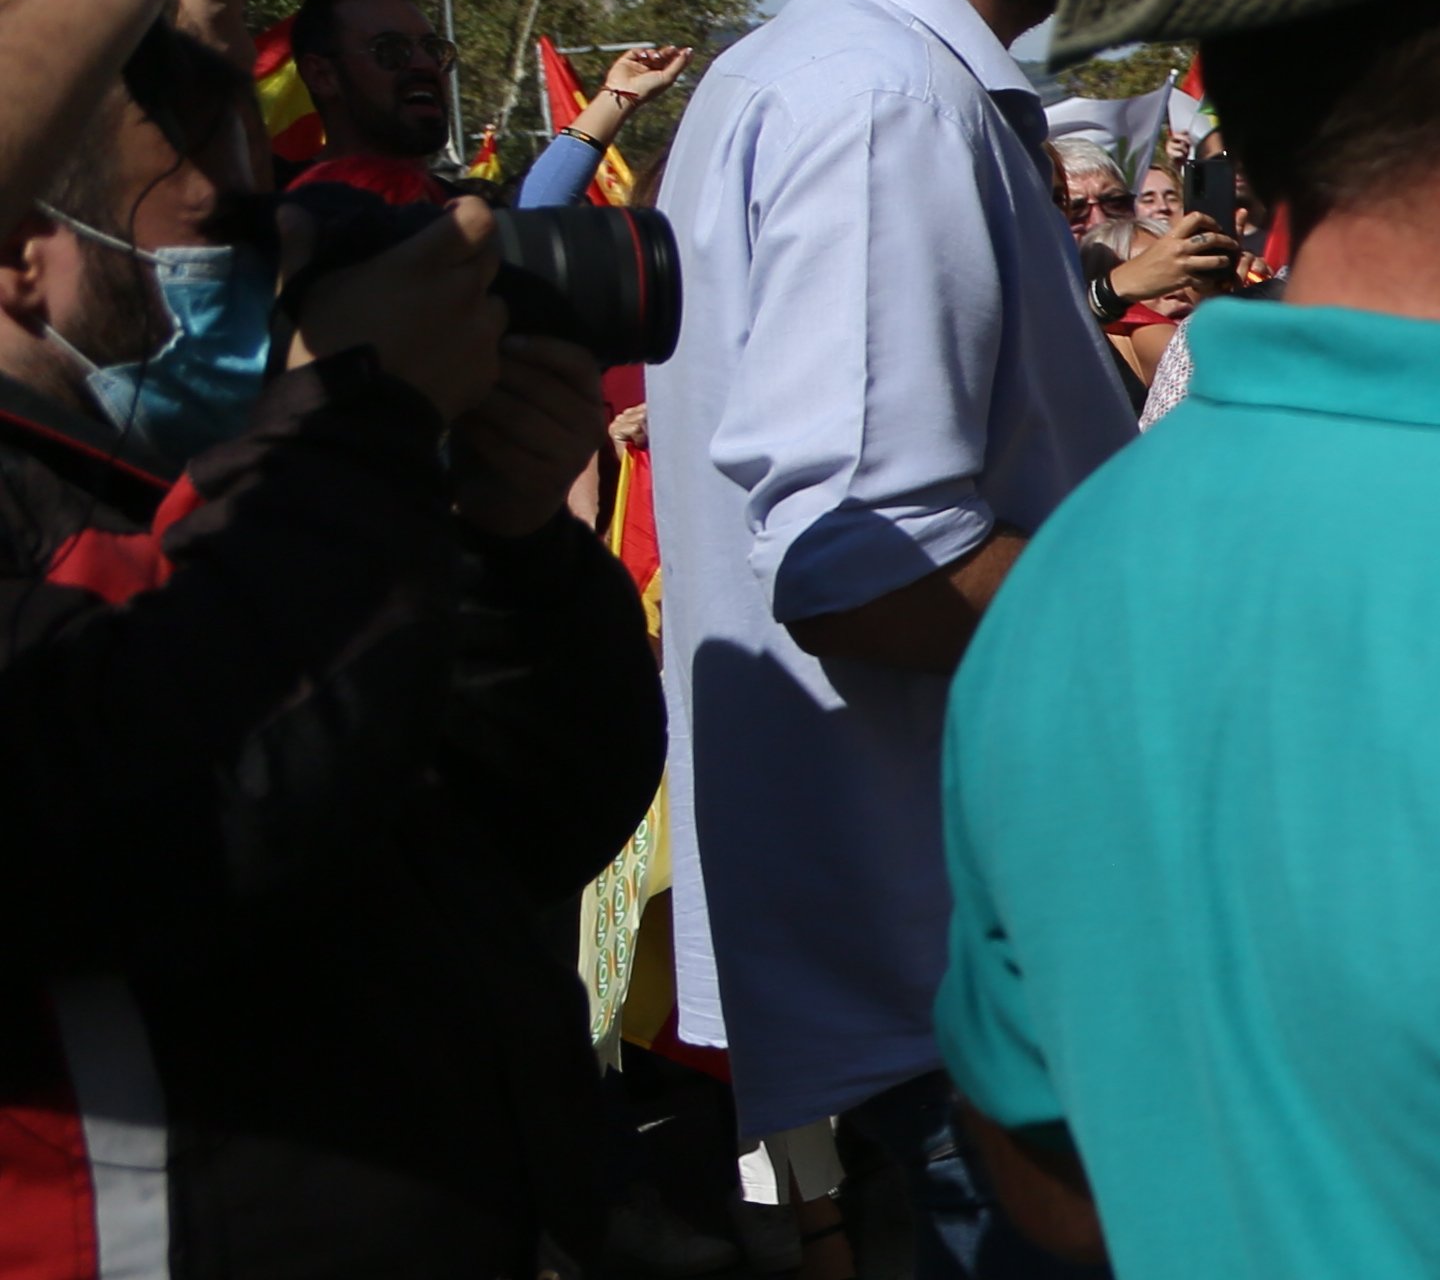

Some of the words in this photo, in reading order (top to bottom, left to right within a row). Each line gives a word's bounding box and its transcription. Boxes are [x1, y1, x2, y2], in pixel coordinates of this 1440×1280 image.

[598, 901, 607, 943] VOX
[615, 878, 625, 927] VOX
[598, 949, 608, 997] VOX
[616, 928, 627, 977] VOX
